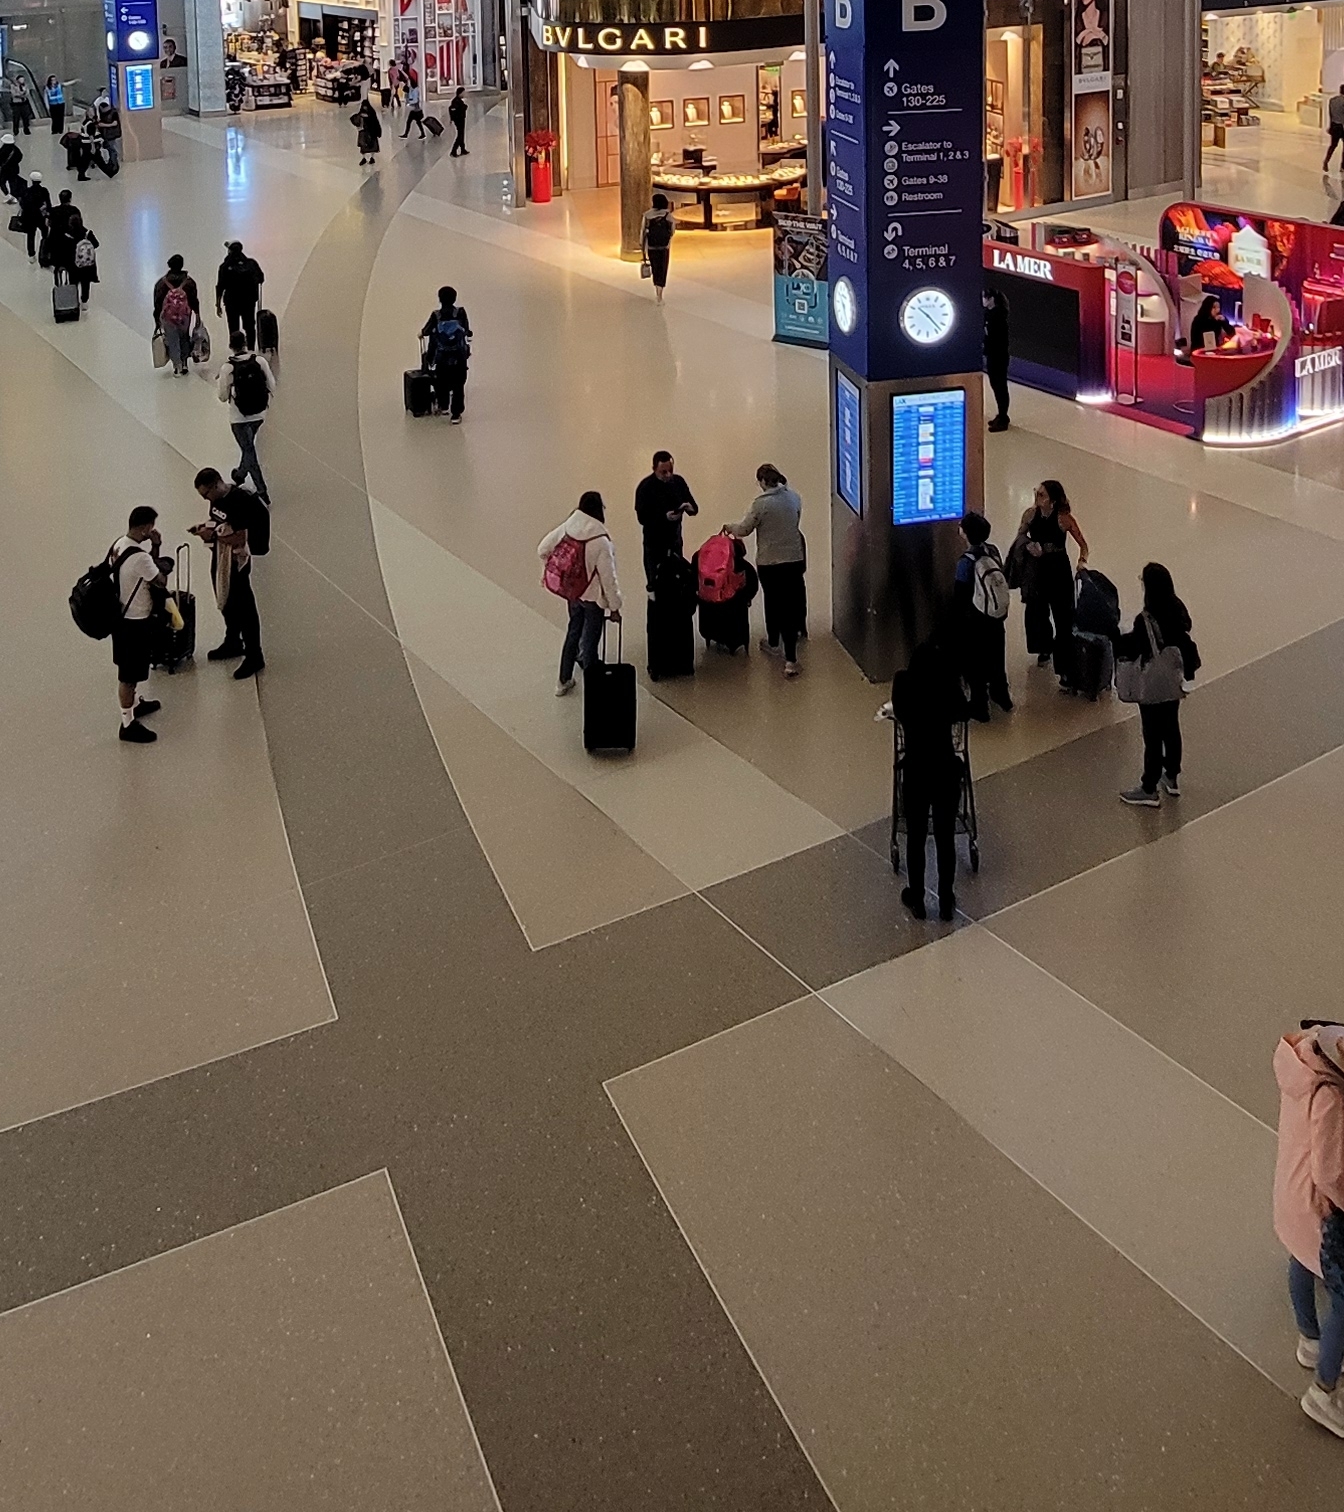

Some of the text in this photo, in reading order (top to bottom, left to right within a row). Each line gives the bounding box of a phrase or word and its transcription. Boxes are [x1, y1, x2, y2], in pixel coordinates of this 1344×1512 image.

[542, 25, 707, 50] BVLGARI
[901, 83, 934, 94] Gates
[901, 94, 947, 107] 130-225
[901, 140, 953, 151] Escalator to
[901, 150, 970, 162] Terminal 1, 2 & 3
[901, 176, 927, 186] Gates
[901, 192, 944, 201] Restroom
[902, 244, 949, 257] Terminal
[902, 255, 956, 271] 4, 5, 6 & 7
[993, 249, 1054, 281] LA MER
[1294, 348, 1343, 378] LA MER
